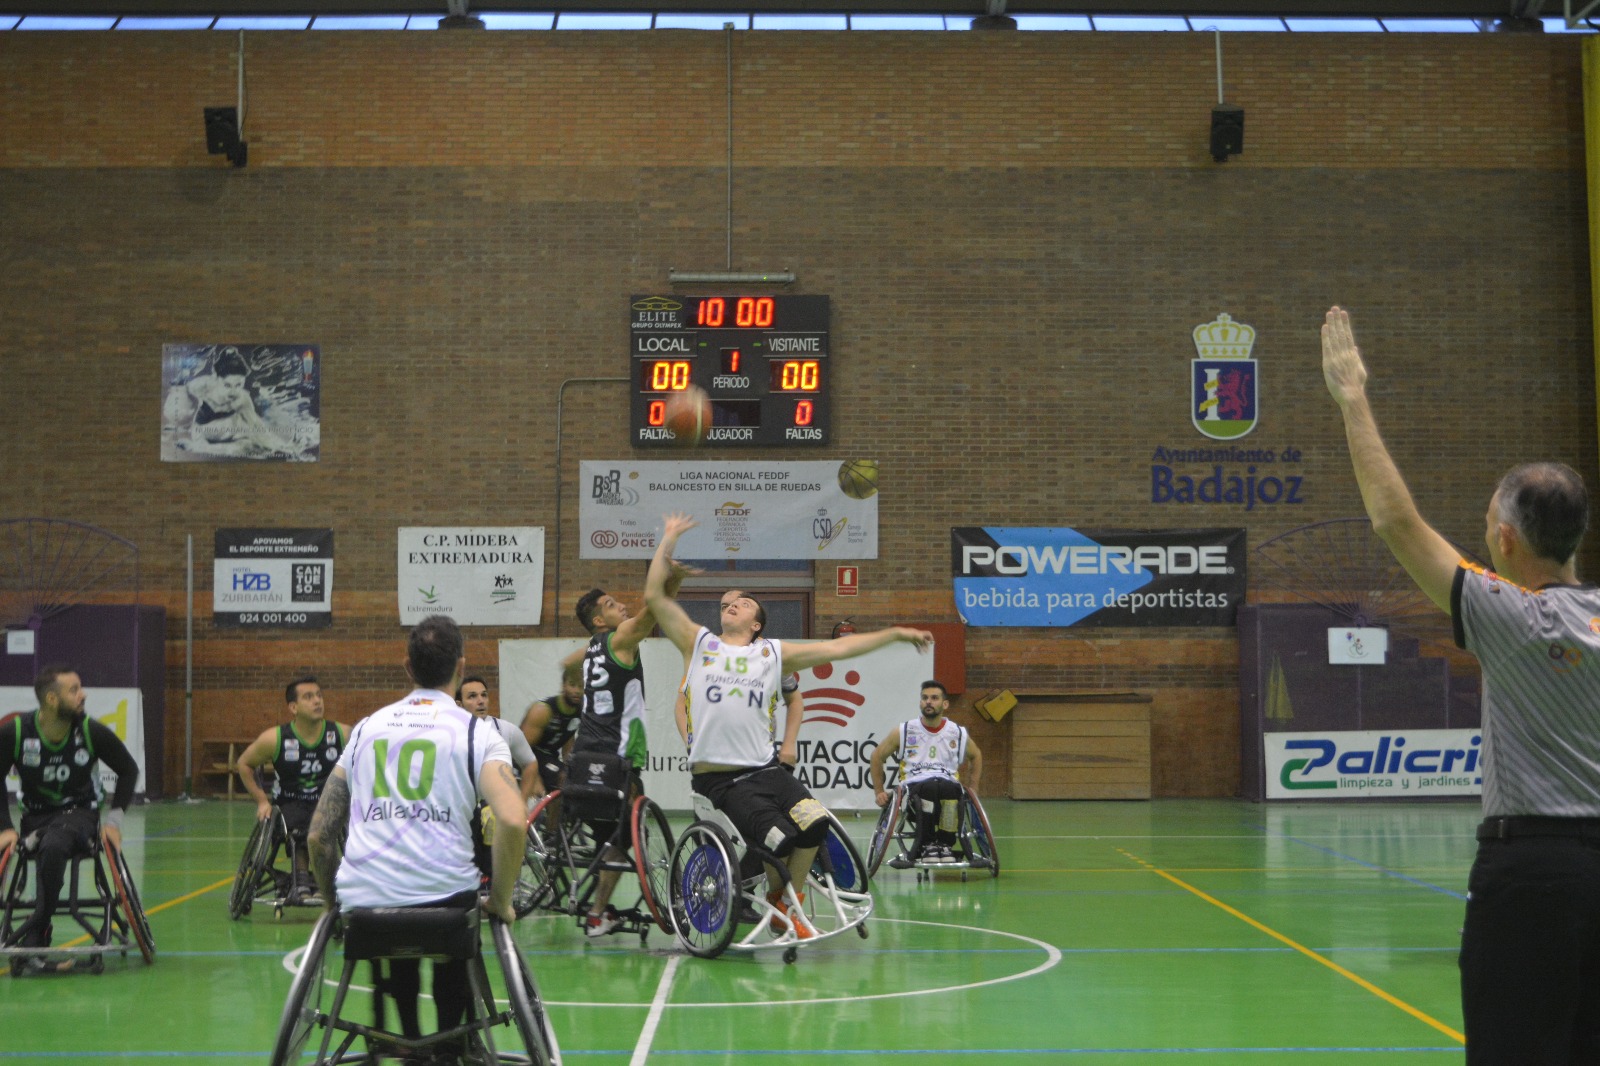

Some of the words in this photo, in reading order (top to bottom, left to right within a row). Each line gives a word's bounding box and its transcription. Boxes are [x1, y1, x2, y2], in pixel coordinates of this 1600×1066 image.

[639, 312, 676, 321] ELITE
[698, 297, 725, 327] 10
[736, 297, 774, 327] 00
[638, 338, 690, 351] LOCAL
[769, 338, 820, 352] VISITANTE
[731, 351, 740, 372] 1
[652, 362, 690, 390] 00
[713, 377, 750, 388] PERIODO
[782, 362, 818, 390] 00
[649, 401, 665, 426] 0
[795, 400, 813, 425] 0
[639, 429, 676, 440] FALTAS
[706, 428, 753, 441] JUGADOR
[785, 429, 822, 440] FALTAS
[1152, 445, 1276, 464] Ayuntamiento
[1281, 446, 1302, 463] de
[680, 472, 703, 480] LIGA
[705, 472, 756, 480] NACIONAL
[758, 472, 791, 480] FEDDF
[592, 469, 621, 498] BSR
[649, 483, 716, 491] BALONCESTO
[718, 483, 732, 491] EN
[734, 483, 762, 491] SILLA
[764, 483, 778, 491] DE
[780, 483, 821, 491] RUEDAS
[1152, 465, 1303, 511] Badajoz
[714, 508, 751, 516] FEDDF
[812, 518, 832, 539] CSD
[253, 537, 294, 545] APOYAMOS
[423, 534, 450, 547] C.P.
[455, 534, 518, 546] MIDEBA
[621, 539, 655, 548] ONCE
[229, 545, 238, 553] EL
[239, 545, 274, 553] DEPORTE
[274, 544, 319, 553] EXTREMEÑO
[408, 552, 534, 564] EXTREMADURA
[296, 566, 321, 575] CAN
[232, 573, 271, 591] HZB
[296, 575, 321, 584] TUE
[222, 593, 283, 602] ZURBARÁN
[964, 587, 1040, 608] bebida
[1047, 592, 1097, 613] para
[1102, 587, 1228, 613] deportistas
[239, 613, 259, 623] 924
[262, 613, 282, 623] 001
[284, 613, 307, 623] 400
[724, 656, 748, 674] 15
[705, 673, 765, 689] FUNDACIÓN
[928, 745, 937, 759] 8
[1280, 735, 1482, 778] Palicri
[301, 759, 323, 774] 26
[372, 738, 437, 801] 10
[796, 765, 900, 789] ADAJOZ
[1340, 777, 1393, 790] limpieza
[1402, 779, 1410, 789] y
[1418, 776, 1471, 789] jardines
